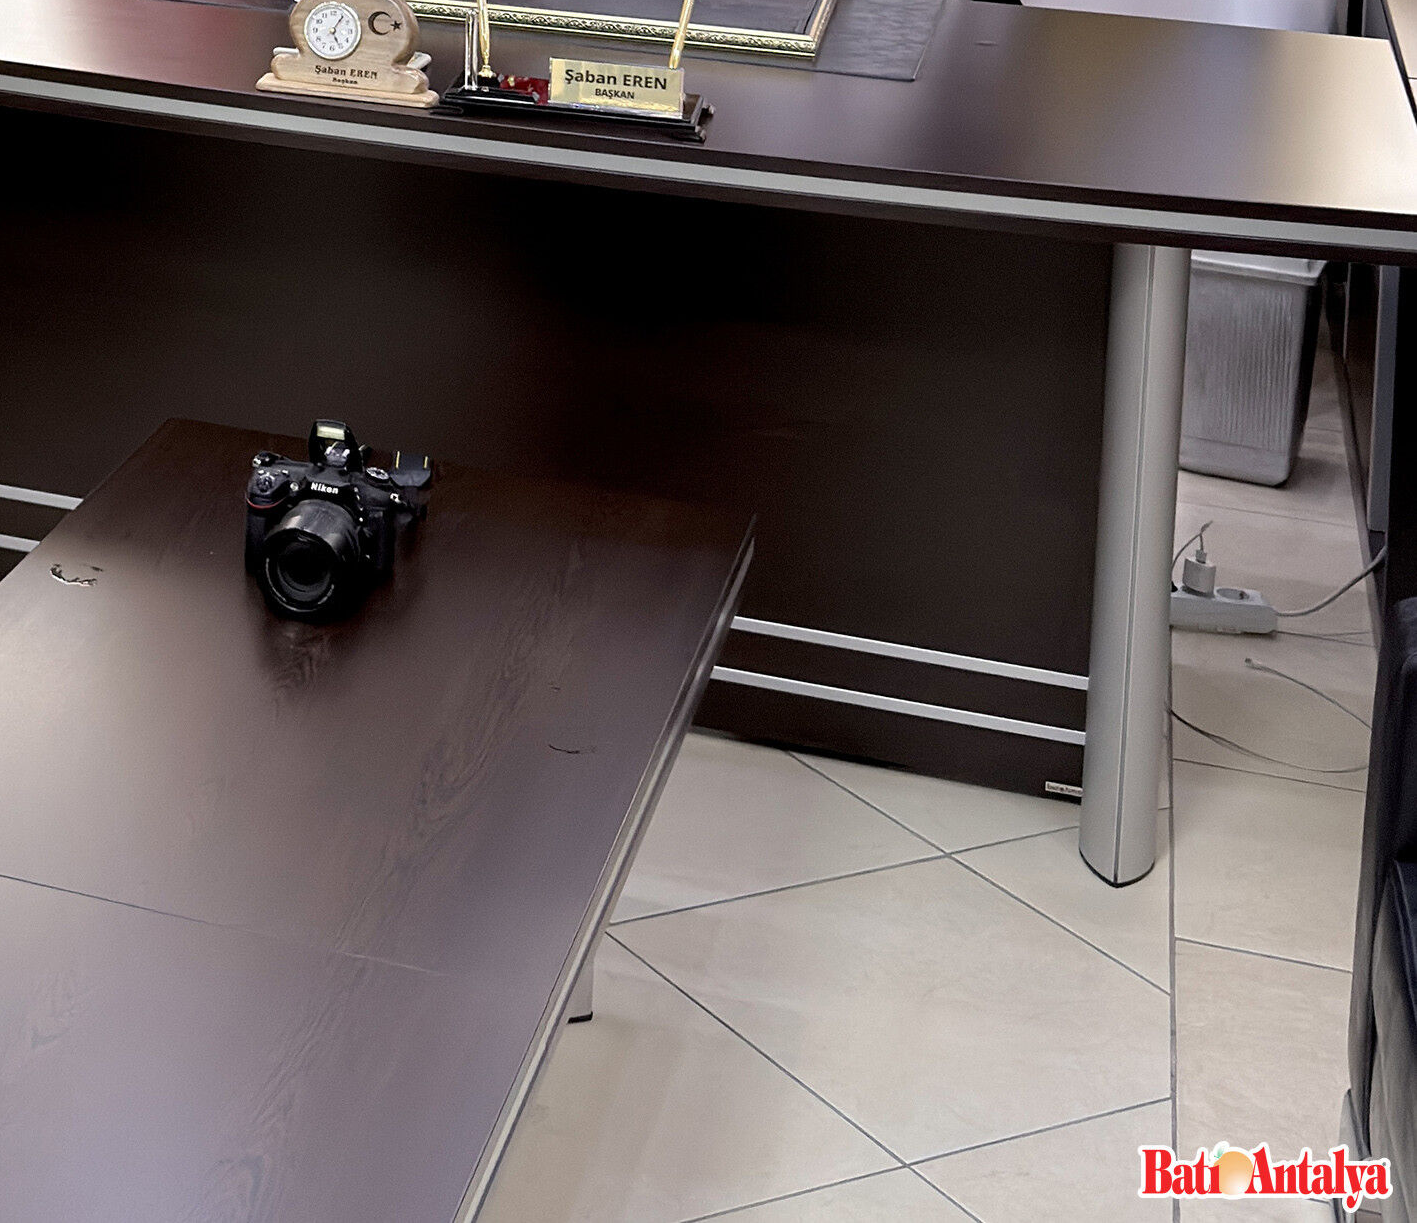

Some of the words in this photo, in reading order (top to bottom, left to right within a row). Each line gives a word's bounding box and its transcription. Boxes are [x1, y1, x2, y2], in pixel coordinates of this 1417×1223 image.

[314, 65, 347, 76] Şaban
[350, 69, 378, 80] EREN
[564, 69, 617, 85] Şaban
[623, 74, 667, 90] EREN
[595, 88, 635, 99] BAŞKAN
[310, 482, 339, 495] Nikon
